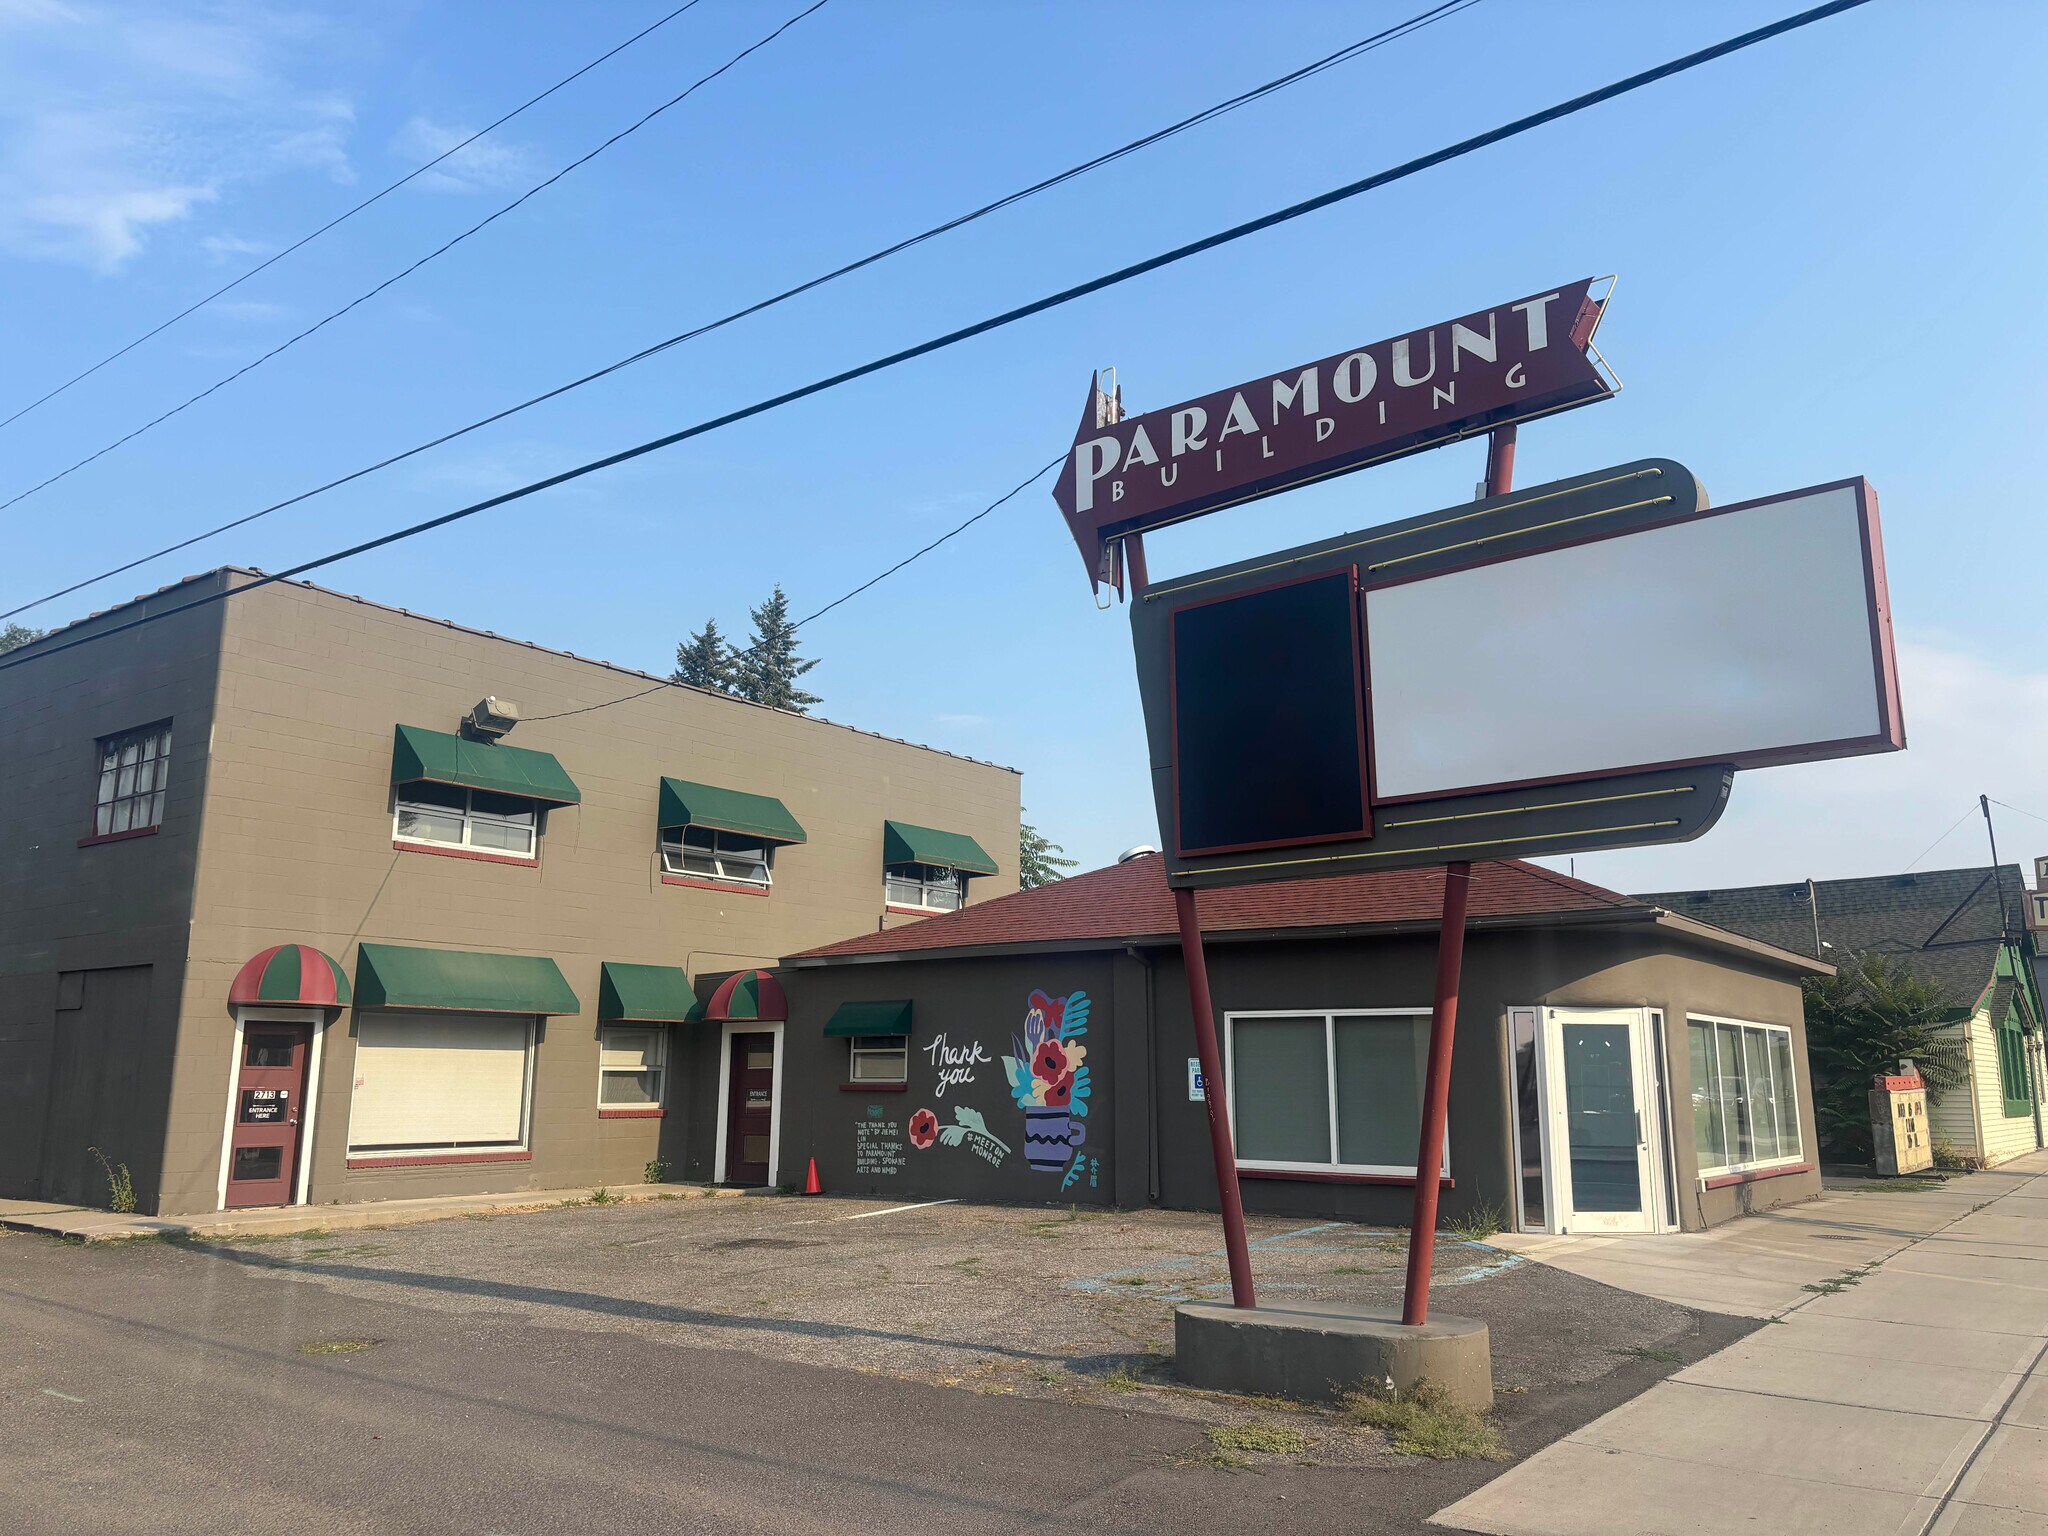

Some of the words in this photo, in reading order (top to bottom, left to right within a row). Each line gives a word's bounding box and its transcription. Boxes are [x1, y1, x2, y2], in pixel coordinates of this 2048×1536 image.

[1075, 292, 1560, 513] PARAMOUNT
[1111, 362, 1527, 502] BUILDING
[923, 1032, 992, 1067] Thank
[935, 1066, 975, 1098] you
[255, 1091, 275, 1099] 2713
[868, 1121, 885, 1129] THANK
[887, 1121, 898, 1129] YOU
[874, 1128, 880, 1136] BY
[857, 1135, 867, 1143] LIN
[857, 1142, 879, 1150] SPECIAL
[880, 1142, 903, 1150] THANKS
[967, 1132, 995, 1151] #MEET
[994, 1146, 1005, 1159] ON
[865, 1149, 896, 1157] PARAMOUNT
[971, 1143, 1002, 1168] MONROE
[882, 1156, 906, 1166] SPOKANE
[856, 1166, 869, 1174] ARTS
[870, 1166, 881, 1174] AND
